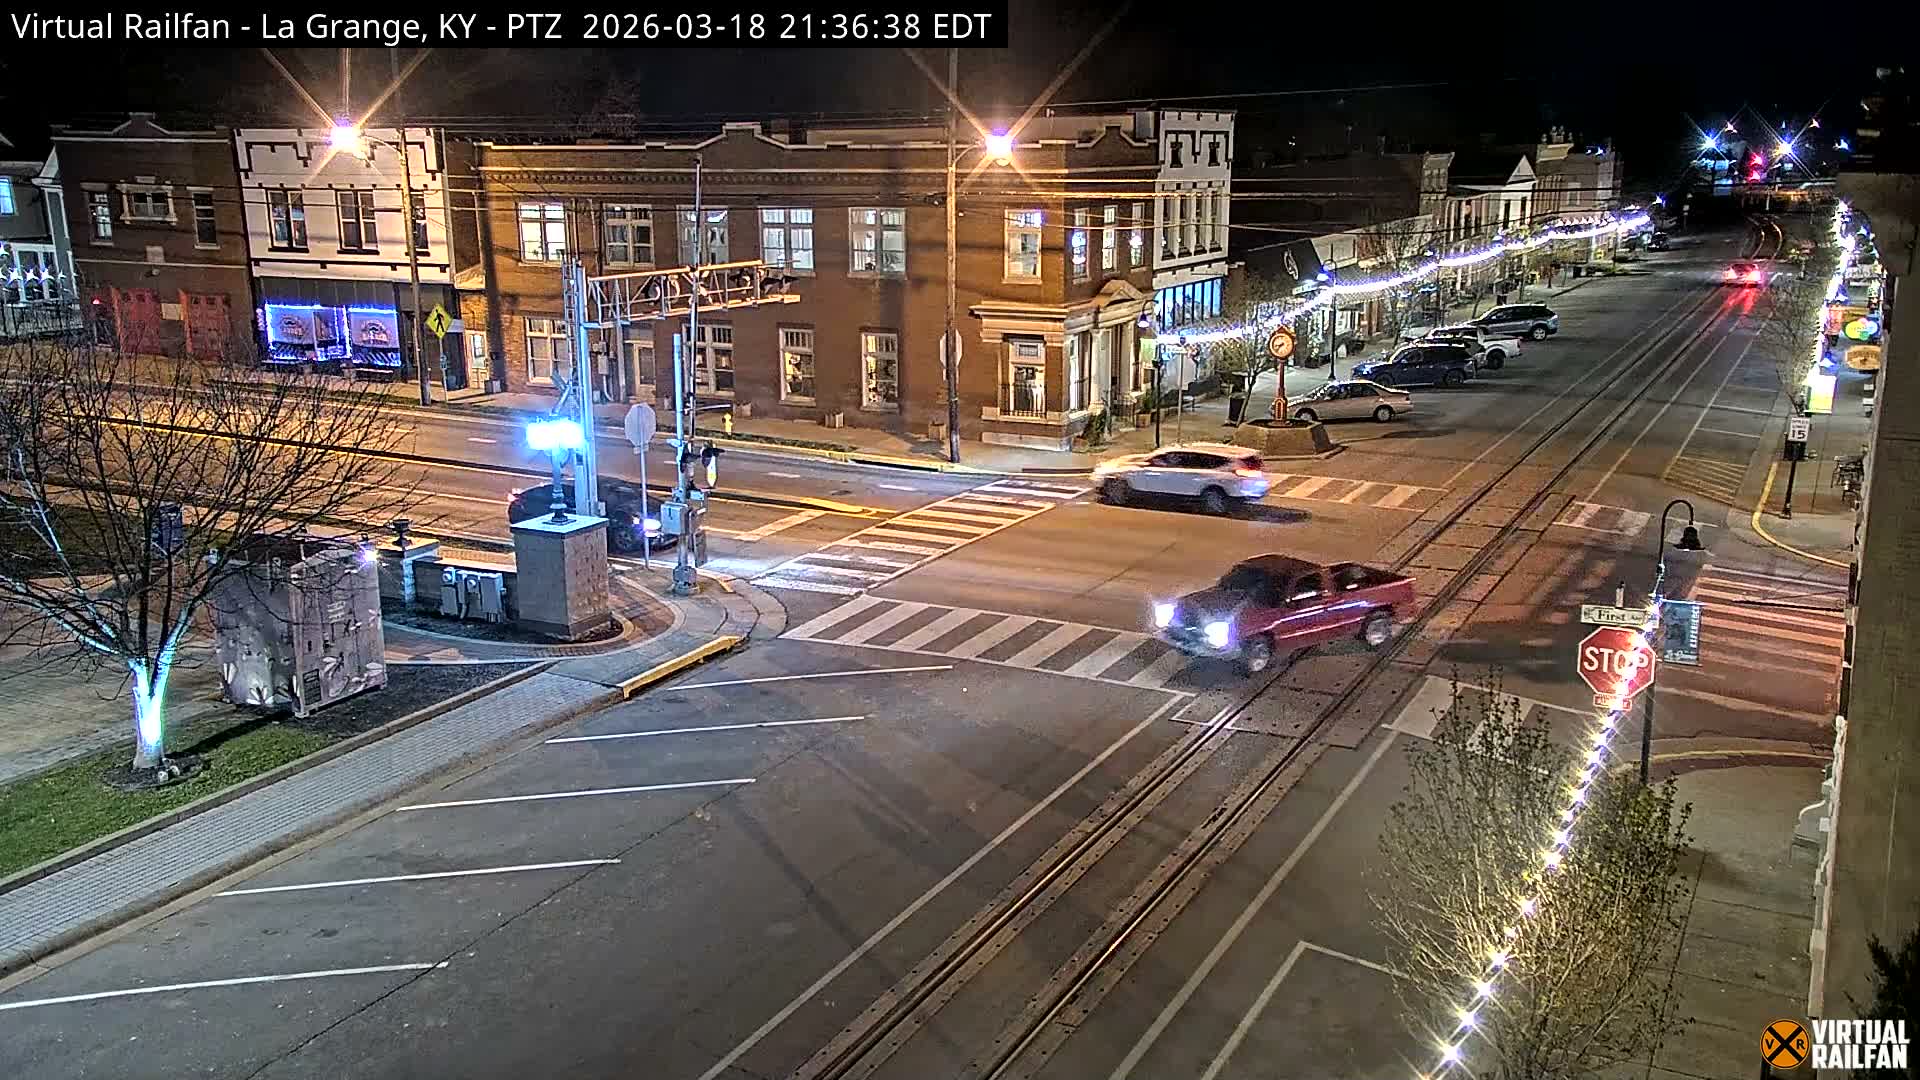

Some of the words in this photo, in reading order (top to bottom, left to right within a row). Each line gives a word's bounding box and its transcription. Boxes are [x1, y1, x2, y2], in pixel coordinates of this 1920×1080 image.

[1792, 430, 1806, 439] 15
[1598, 609, 1625, 621] First
[1583, 646, 1649, 676] STOP
